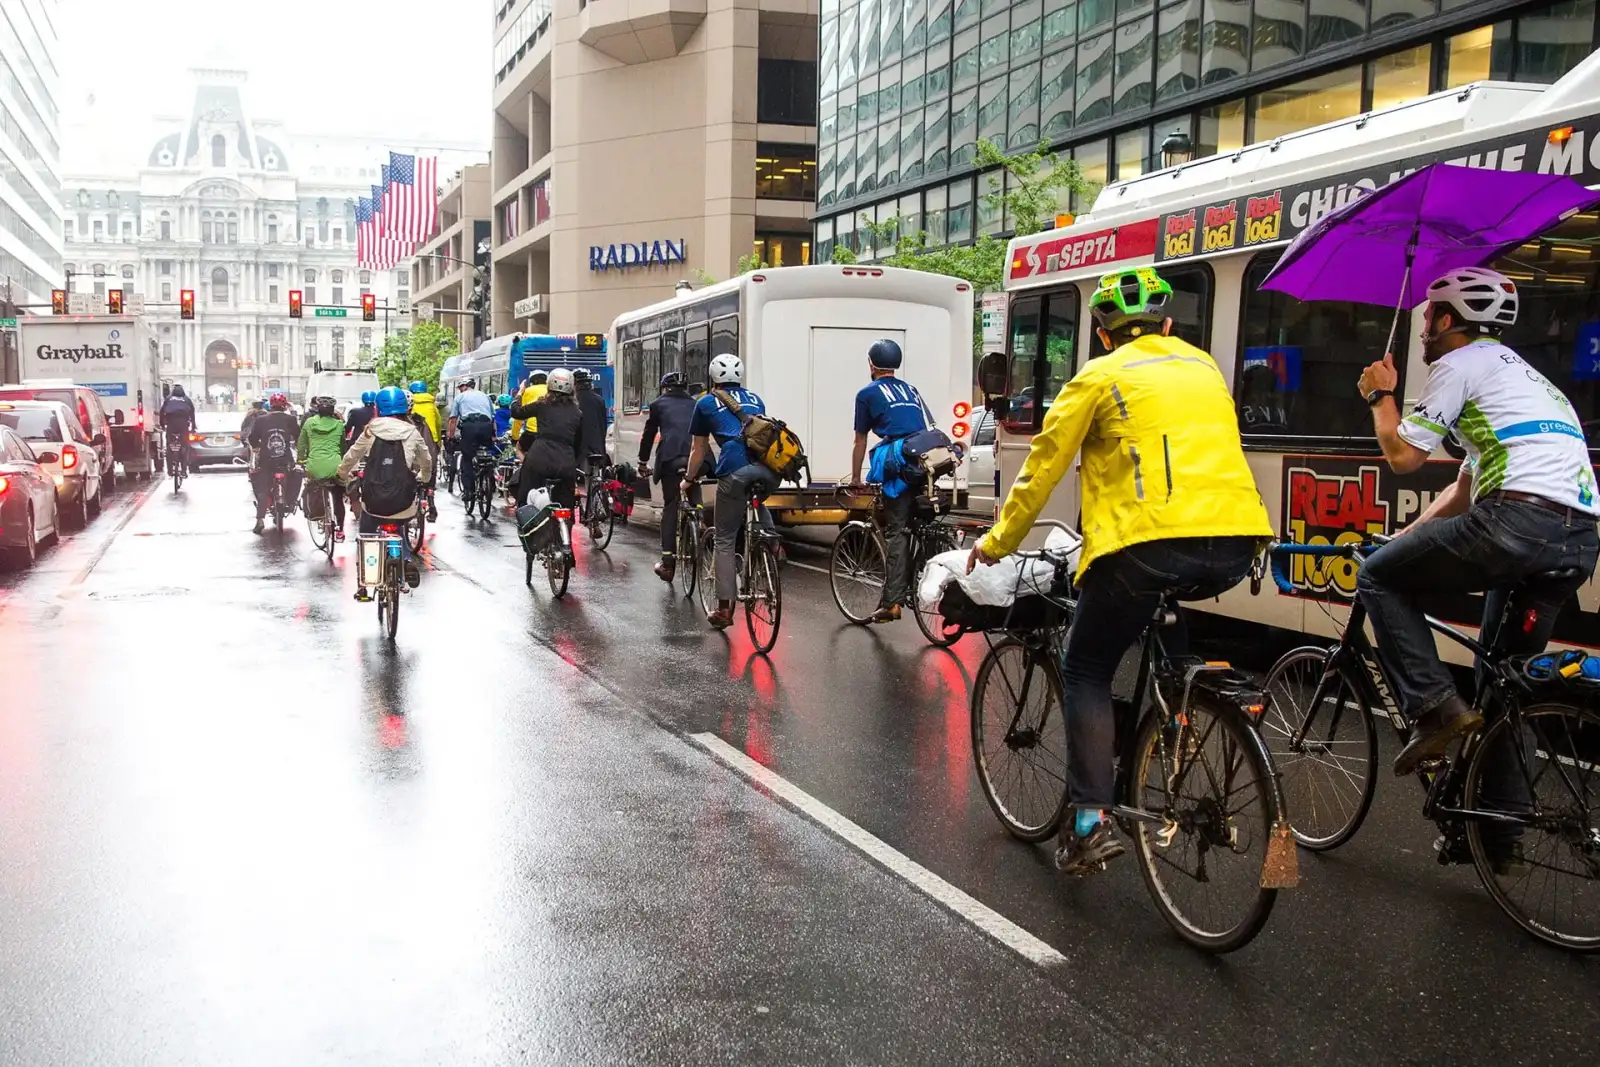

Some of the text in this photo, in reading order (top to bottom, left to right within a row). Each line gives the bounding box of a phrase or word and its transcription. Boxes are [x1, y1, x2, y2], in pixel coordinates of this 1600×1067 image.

[1537, 128, 1600, 175] M
[1204, 200, 1237, 227] REAL
[1246, 194, 1281, 218] REAL
[1167, 210, 1196, 235] REAL
[589, 238, 684, 271] RADIAN
[1058, 234, 1117, 268] SEPTA
[37, 344, 124, 363] GraybaR
[584, 335, 598, 346] 32
[1291, 471, 1385, 530] REAL
[1361, 653, 1407, 729] JAMIS
